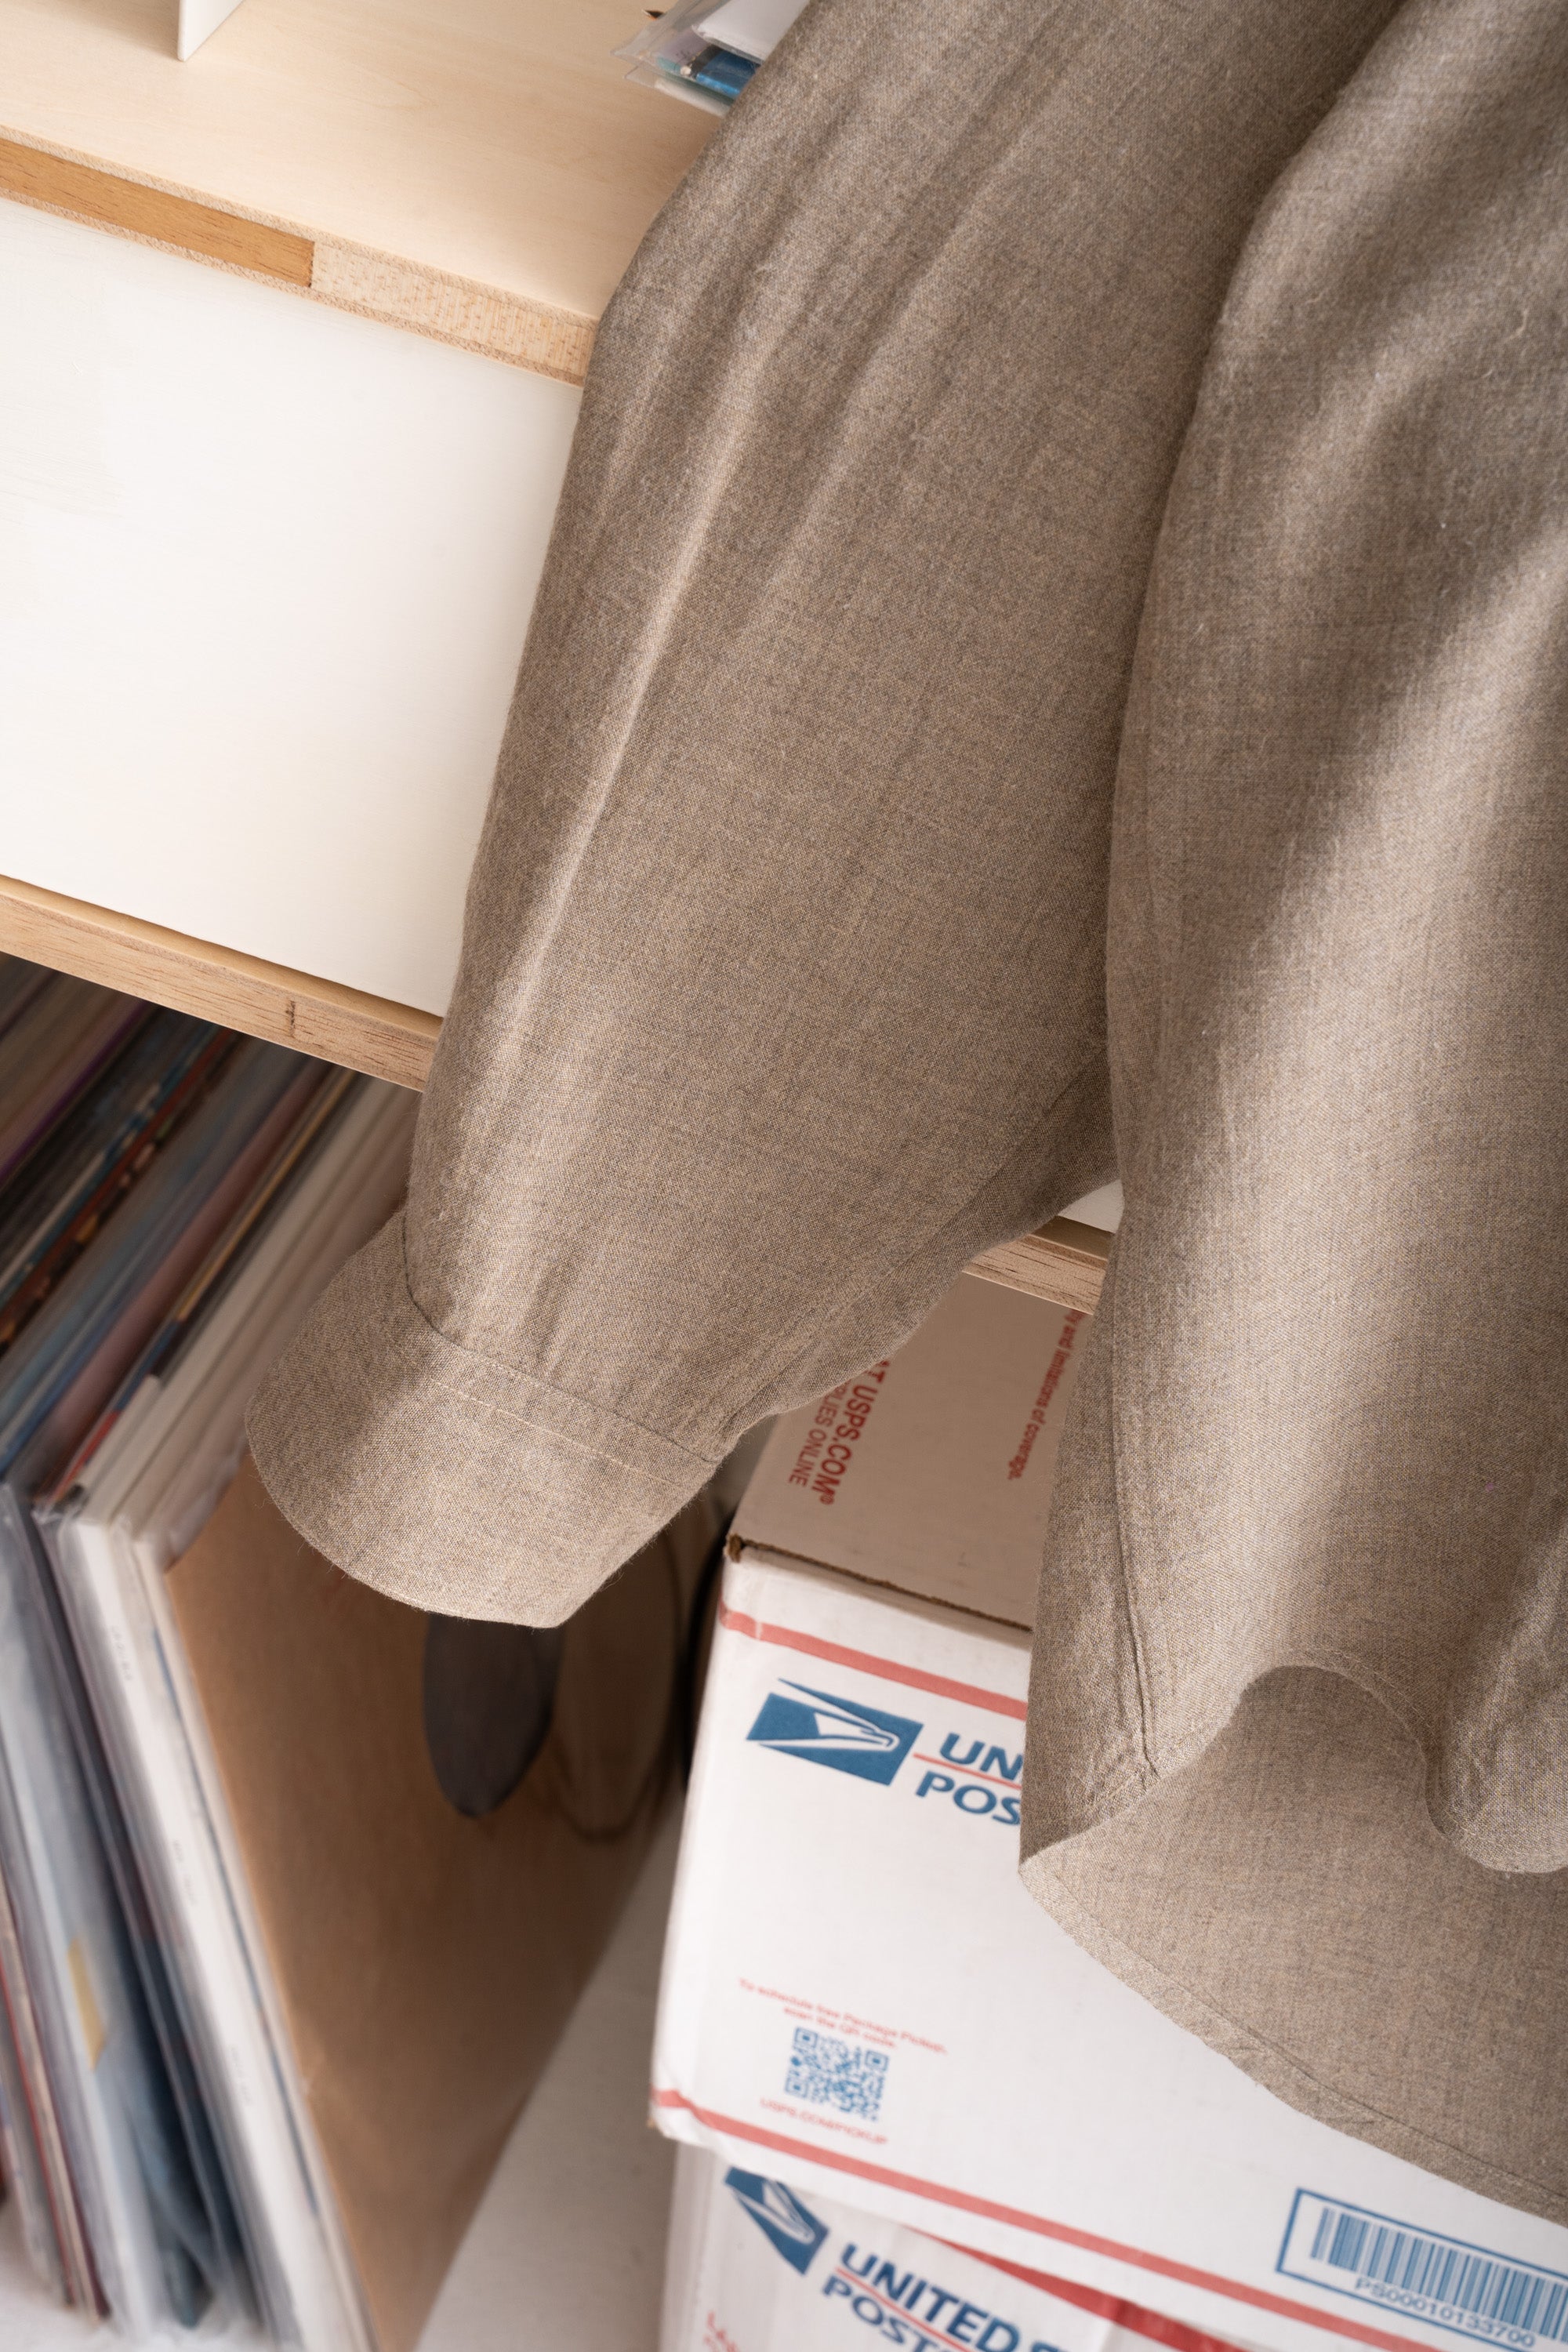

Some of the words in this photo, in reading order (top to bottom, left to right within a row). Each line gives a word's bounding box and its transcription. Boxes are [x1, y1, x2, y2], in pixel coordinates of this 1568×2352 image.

[815, 1378, 852, 1427] PLIES
[1036, 1348, 1071, 1408] limitations
[1031, 1408, 1046, 1425] of
[789, 1428, 827, 1486] ONLINE
[940, 1732, 1024, 1780] UN
[916, 1770, 1021, 1825] POS
[821, 2274, 951, 2352] POST
[840, 2243, 1021, 2352] UNITED
